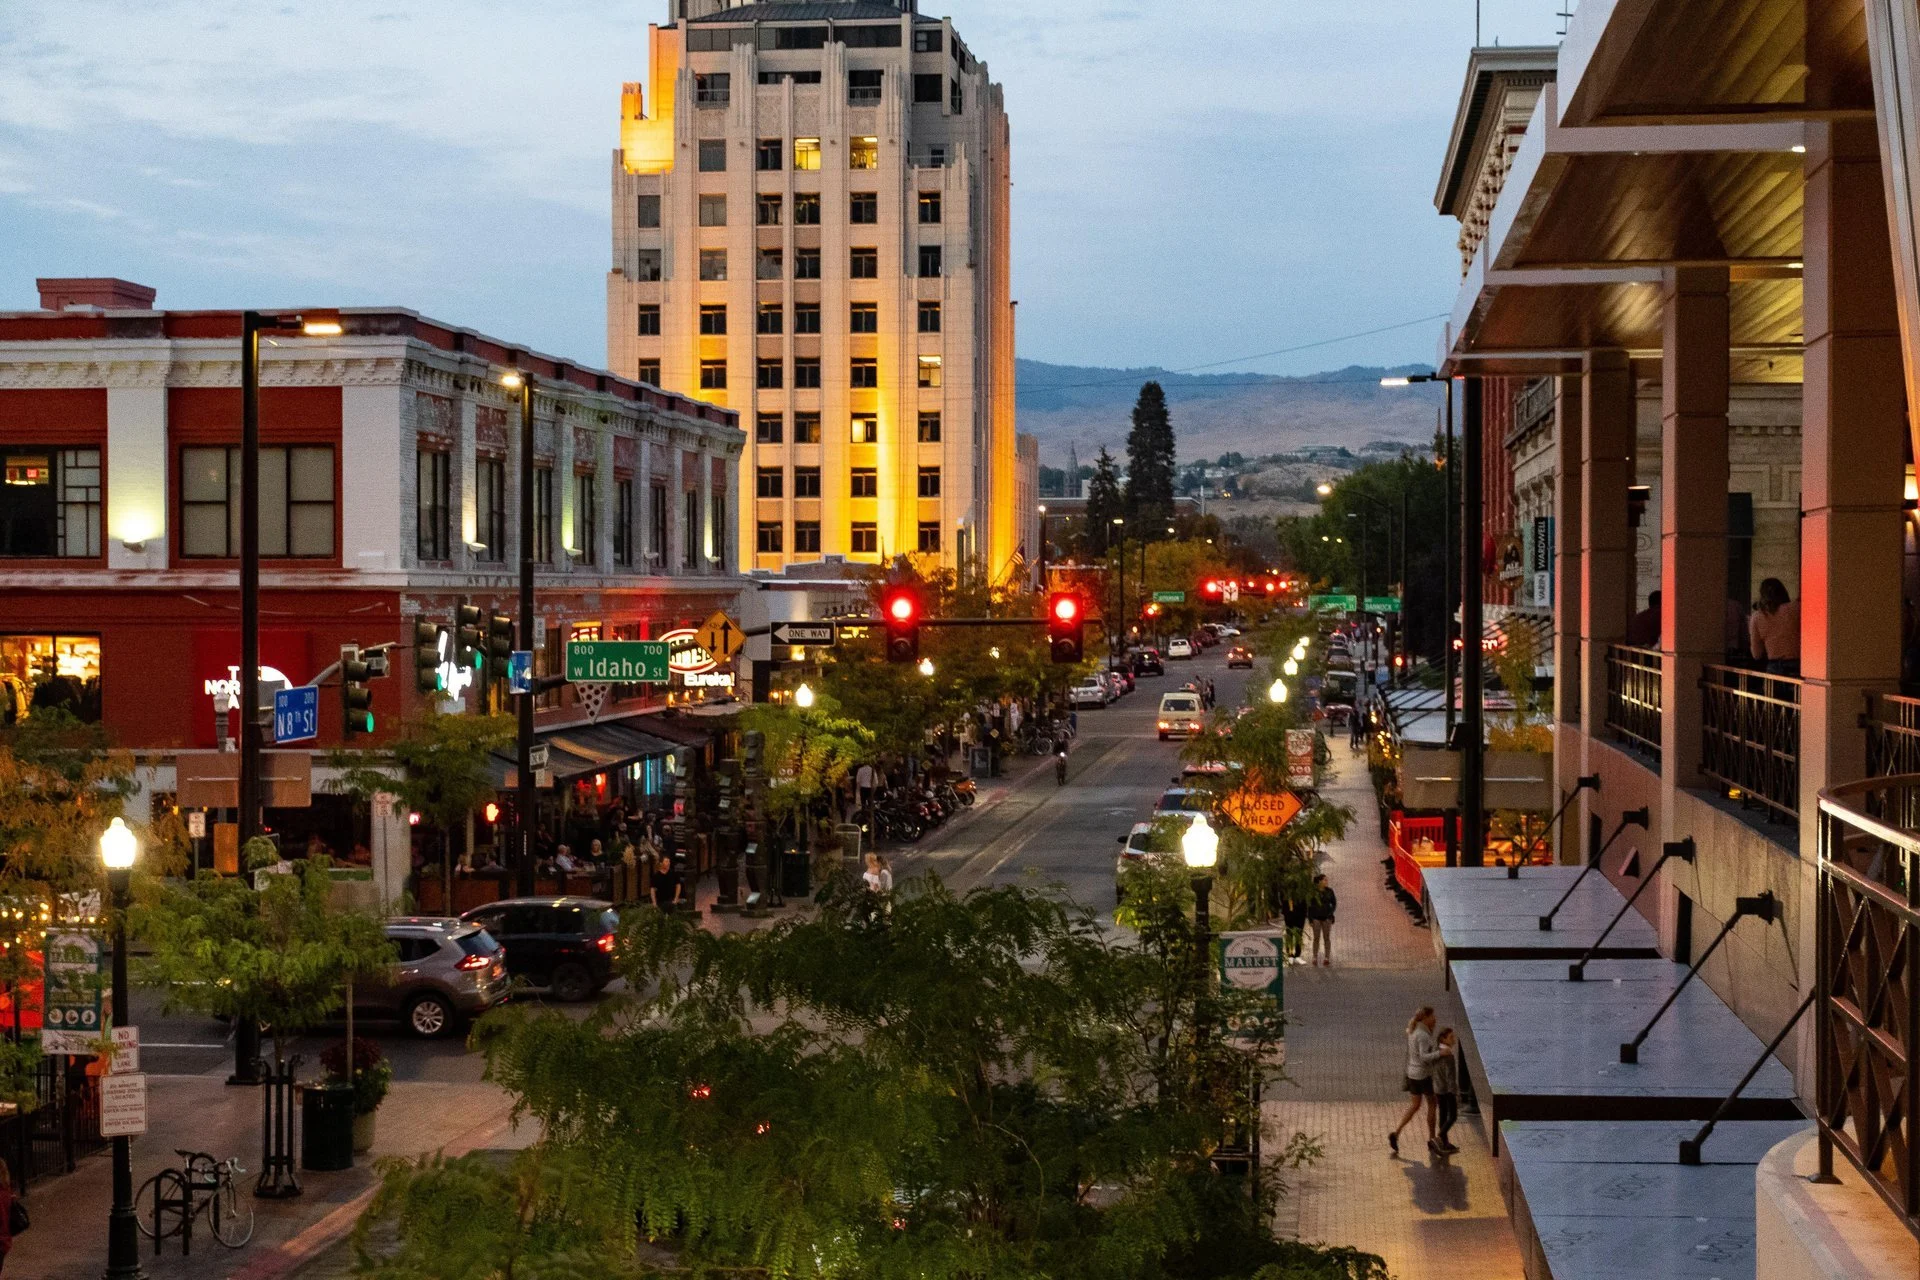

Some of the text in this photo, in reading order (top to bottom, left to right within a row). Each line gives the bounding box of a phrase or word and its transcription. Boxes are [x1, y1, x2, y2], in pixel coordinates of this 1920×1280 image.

[1537, 520, 1546, 569] WARDWELL
[1506, 562, 1520, 571] ALE
[789, 628, 828, 637] ONE WAY
[574, 645, 663, 655] 800 700
[574, 658, 663, 677] W Idaho St
[684, 672, 735, 687] Eureka!
[205, 680, 241, 695] NOR
[278, 713, 285, 737] N
[303, 709, 314, 733] St
[1243, 947, 1259, 956] The
[1225, 956, 1278, 968] MARKET
[118, 1031, 130, 1041] NO
